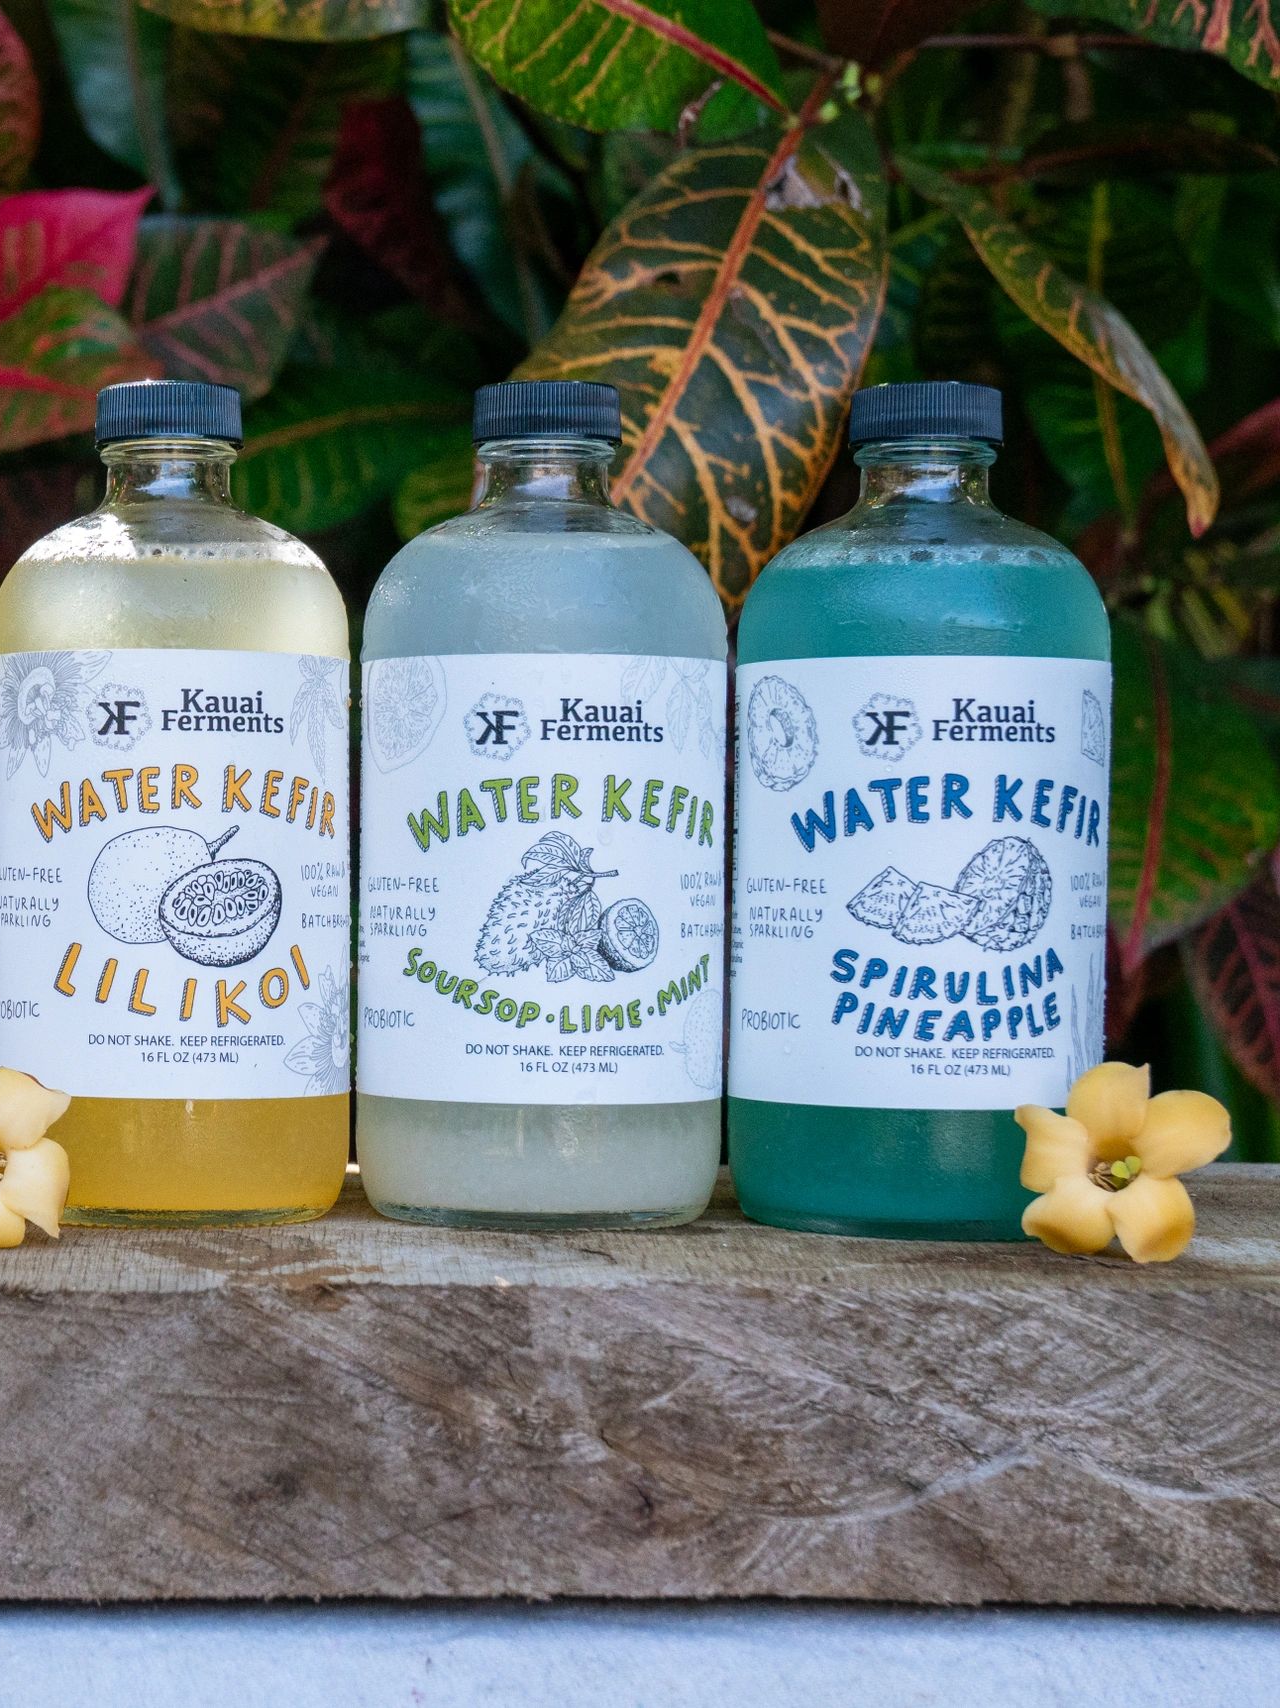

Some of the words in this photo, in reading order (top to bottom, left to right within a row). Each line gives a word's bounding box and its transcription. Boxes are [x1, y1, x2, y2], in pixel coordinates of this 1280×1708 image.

[180, 688, 263, 713] Kauai
[560, 697, 642, 723] Kauai
[952, 697, 1035, 723] Kauai
[161, 709, 284, 734] Ferments
[540, 719, 664, 743] Ferments
[932, 719, 1056, 743] Ferments
[31, 763, 202, 843] WATER
[222, 764, 335, 839] KEFIR
[406, 773, 582, 853] WATER
[601, 774, 714, 849] KEFIR
[790, 773, 973, 853] WATER
[993, 774, 1101, 849] KEFIR
[300, 862, 324, 881] 100%
[680, 871, 702, 890] 100%
[310, 884, 339, 898] VEGAN
[367, 876, 440, 893] GLUTEN-FREE
[746, 877, 828, 895] GLUTEN-FREE
[1070, 872, 1090, 892] 100%
[689, 894, 716, 908] VEGAN
[1079, 894, 1101, 909] VEGAN
[369, 904, 436, 921] NATURALLY
[749, 905, 823, 923] NATURALLY
[369, 922, 427, 937] SPARKLING
[749, 924, 815, 939] SPARKLING
[54, 941, 310, 1027] LILIKOI
[829, 947, 1064, 1006] SPIRULINA
[363, 1005, 415, 1030] PROBIOTIC
[741, 1008, 801, 1031] PROBIOTIC
[831, 991, 1062, 1042] PINEAPPLE
[88, 1033, 106, 1046] DO
[107, 1034, 132, 1046] NOT
[133, 1034, 175, 1047] SHAKE.
[179, 1035, 208, 1048] KEEP
[210, 1034, 286, 1047] REFRIGERATED.
[465, 1043, 484, 1055] DO
[485, 1043, 511, 1056] NOT
[512, 1044, 554, 1057] SHAKE.
[558, 1045, 588, 1057] KEEP
[589, 1044, 665, 1057] REFRIGERATED.
[141, 1051, 155, 1063] 16
[156, 1051, 171, 1063] FL
[172, 1051, 190, 1063] OZ
[192, 1052, 217, 1065] (473
[219, 1051, 240, 1065] ML)
[854, 1045, 874, 1058] DO
[875, 1046, 902, 1058] NOT
[903, 1046, 946, 1059] SHAKE.
[951, 1047, 980, 1060] KEEP
[982, 1046, 1056, 1060] REFRIGERATED.
[519, 1061, 534, 1073] 16
[535, 1061, 550, 1073] FL
[551, 1061, 569, 1073] OZ
[571, 1062, 596, 1075] (473
[598, 1061, 619, 1075] ML)
[910, 1063, 925, 1075] 16
[927, 1063, 942, 1076] FL
[943, 1064, 962, 1076] OZ
[963, 1064, 989, 1078] (473
[990, 1064, 1011, 1077] ML)
